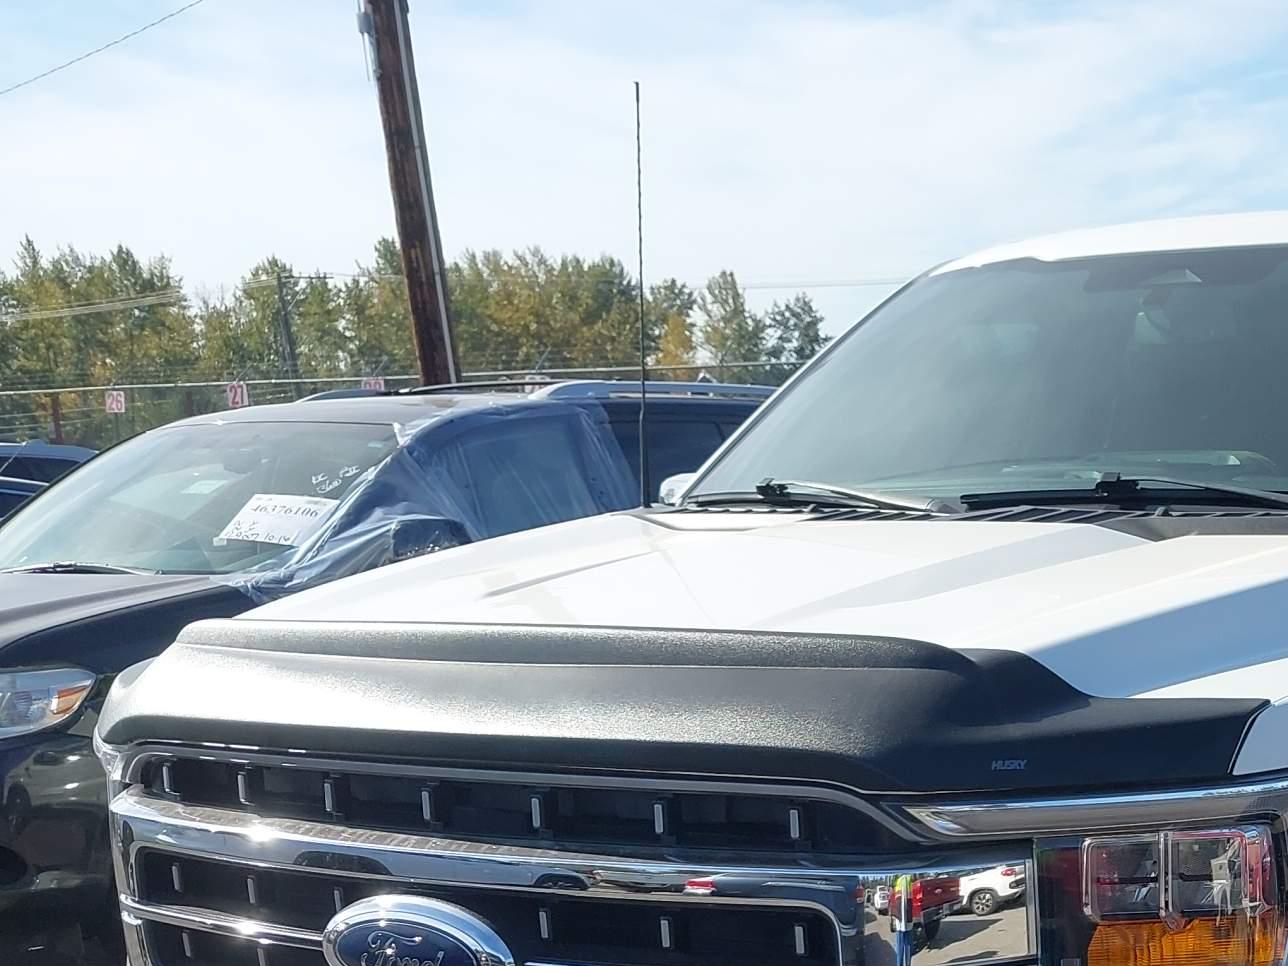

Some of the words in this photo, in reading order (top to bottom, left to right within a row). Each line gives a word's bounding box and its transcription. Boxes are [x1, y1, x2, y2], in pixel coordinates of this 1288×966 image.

[108, 392, 123, 412] 26
[228, 384, 245, 406] 27
[991, 759, 1028, 771] HUSKY
